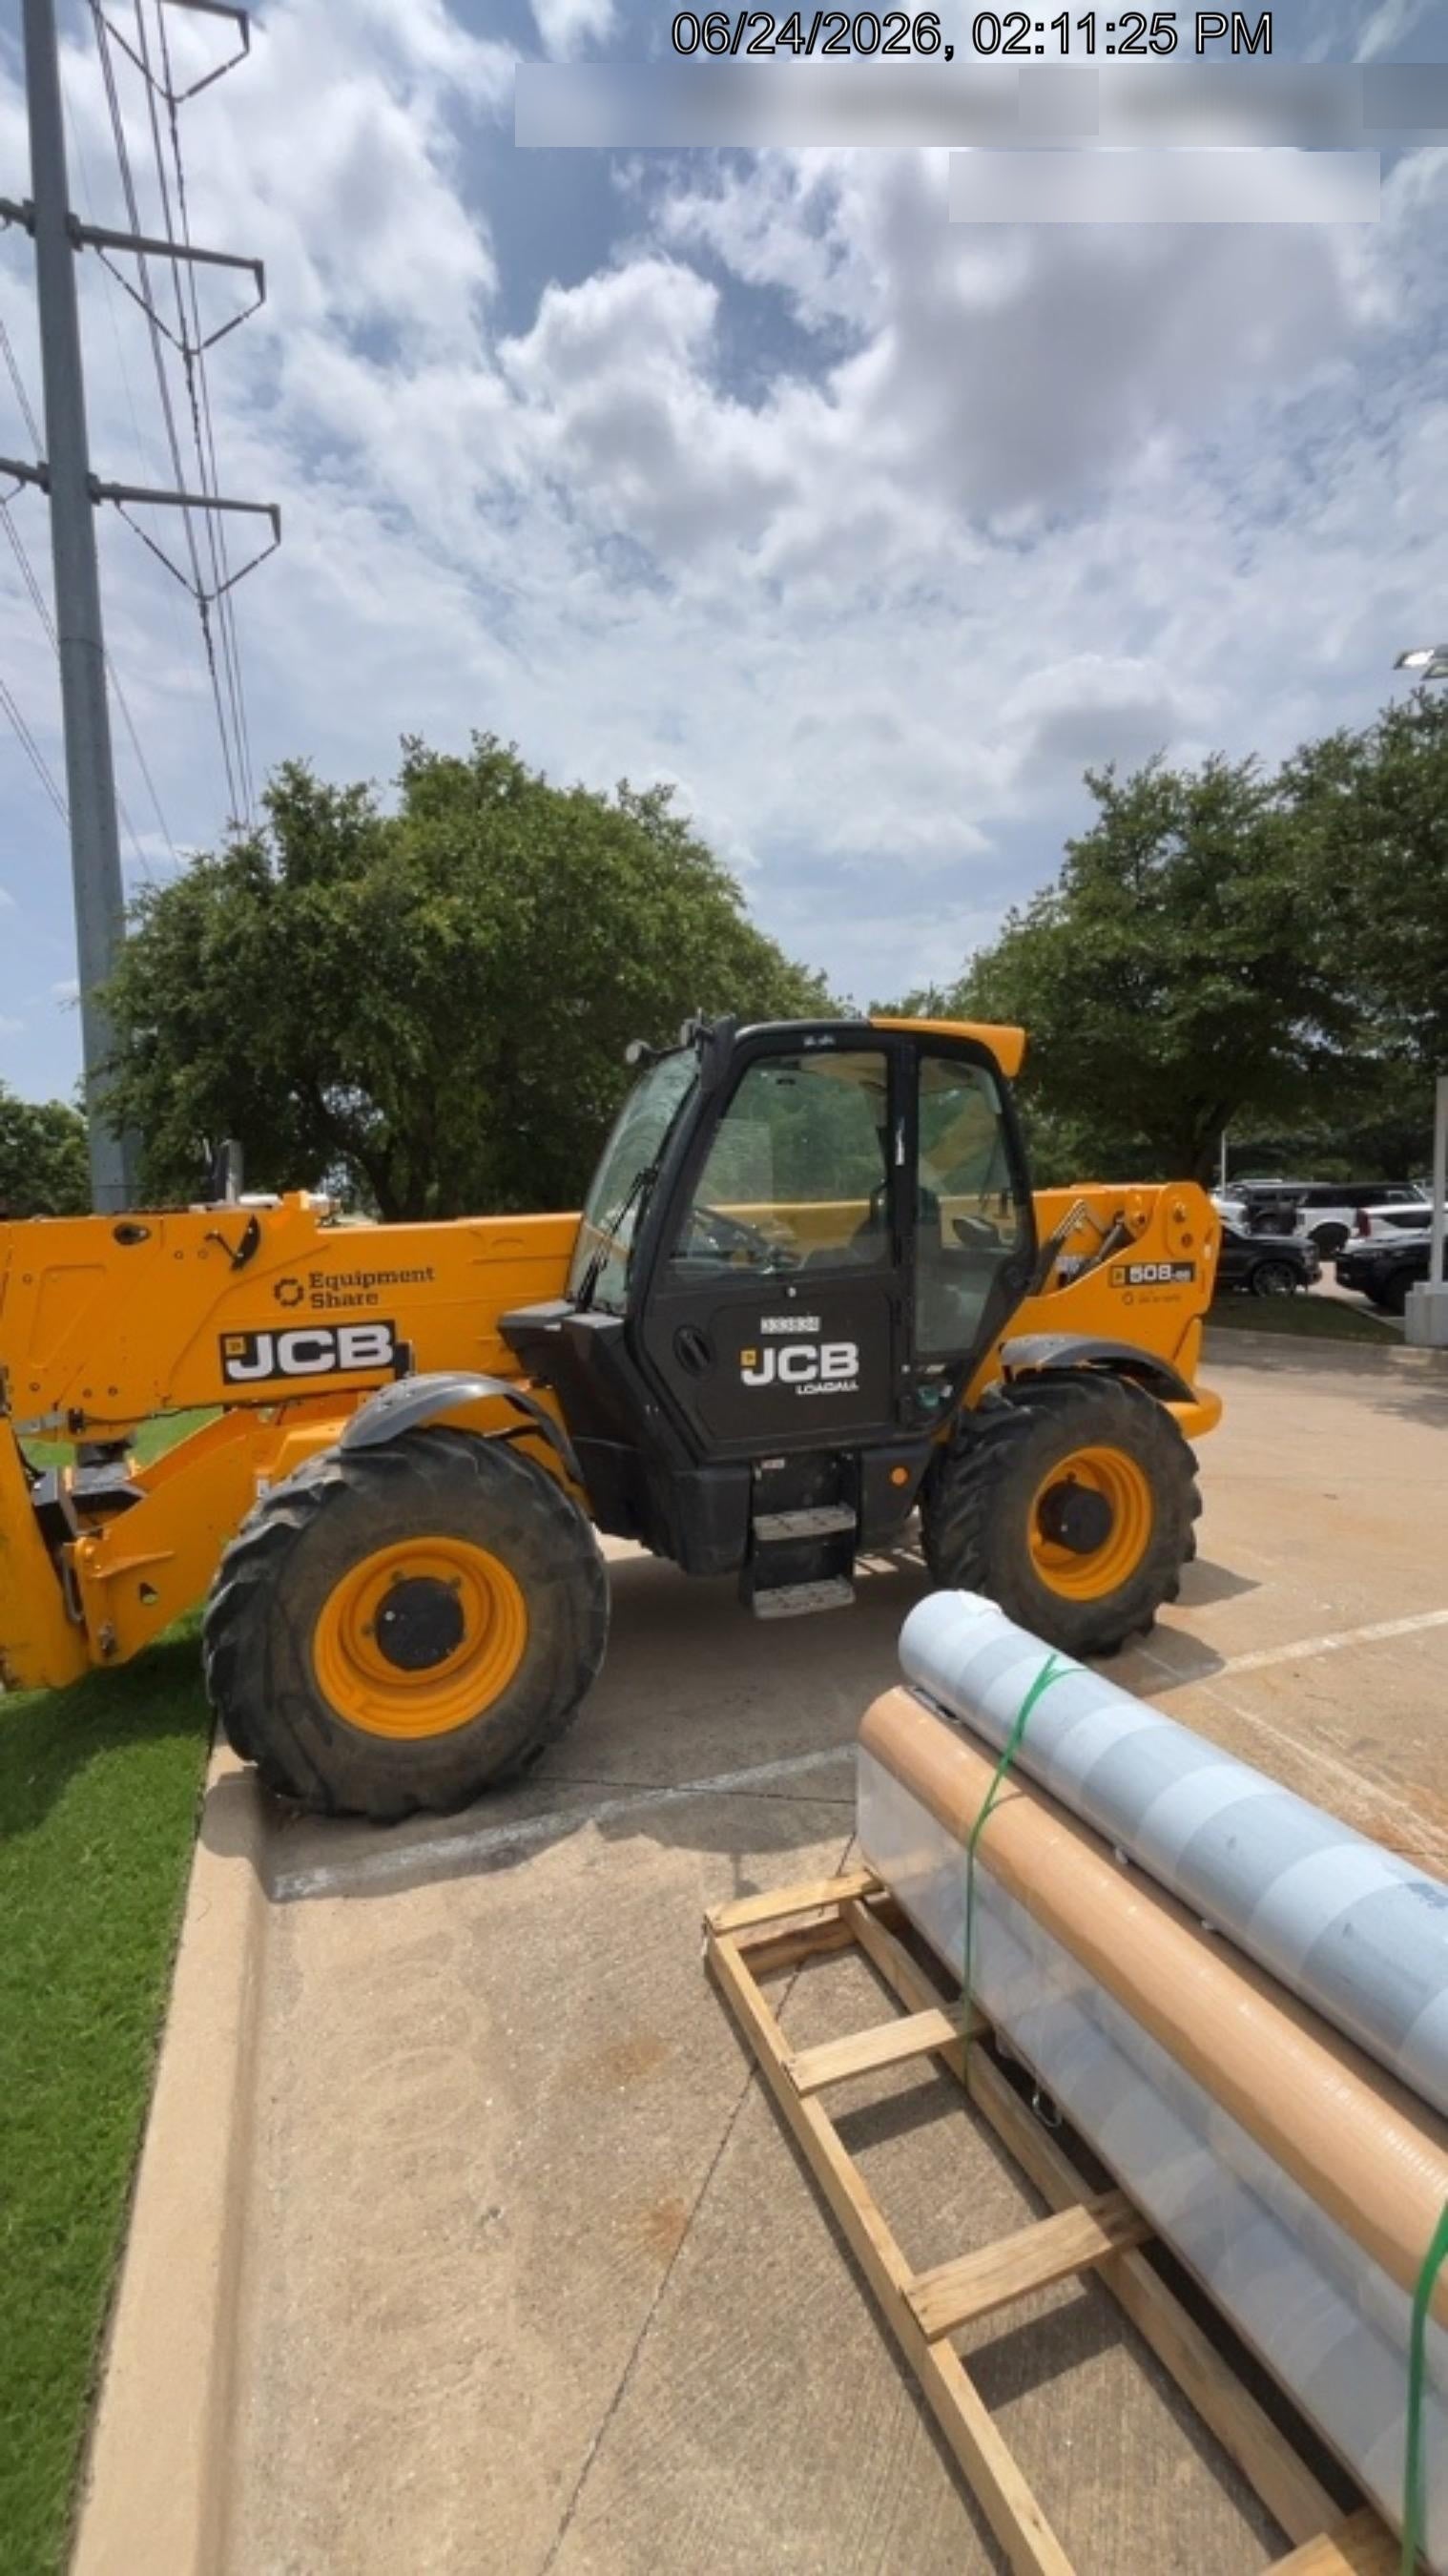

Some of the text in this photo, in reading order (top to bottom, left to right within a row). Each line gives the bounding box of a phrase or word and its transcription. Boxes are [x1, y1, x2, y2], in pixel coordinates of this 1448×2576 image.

[309, 1267, 435, 1290] Equipment
[310, 1292, 379, 1309] Share
[227, 1323, 394, 1381] JCB
[740, 1341, 859, 1386] JCB
